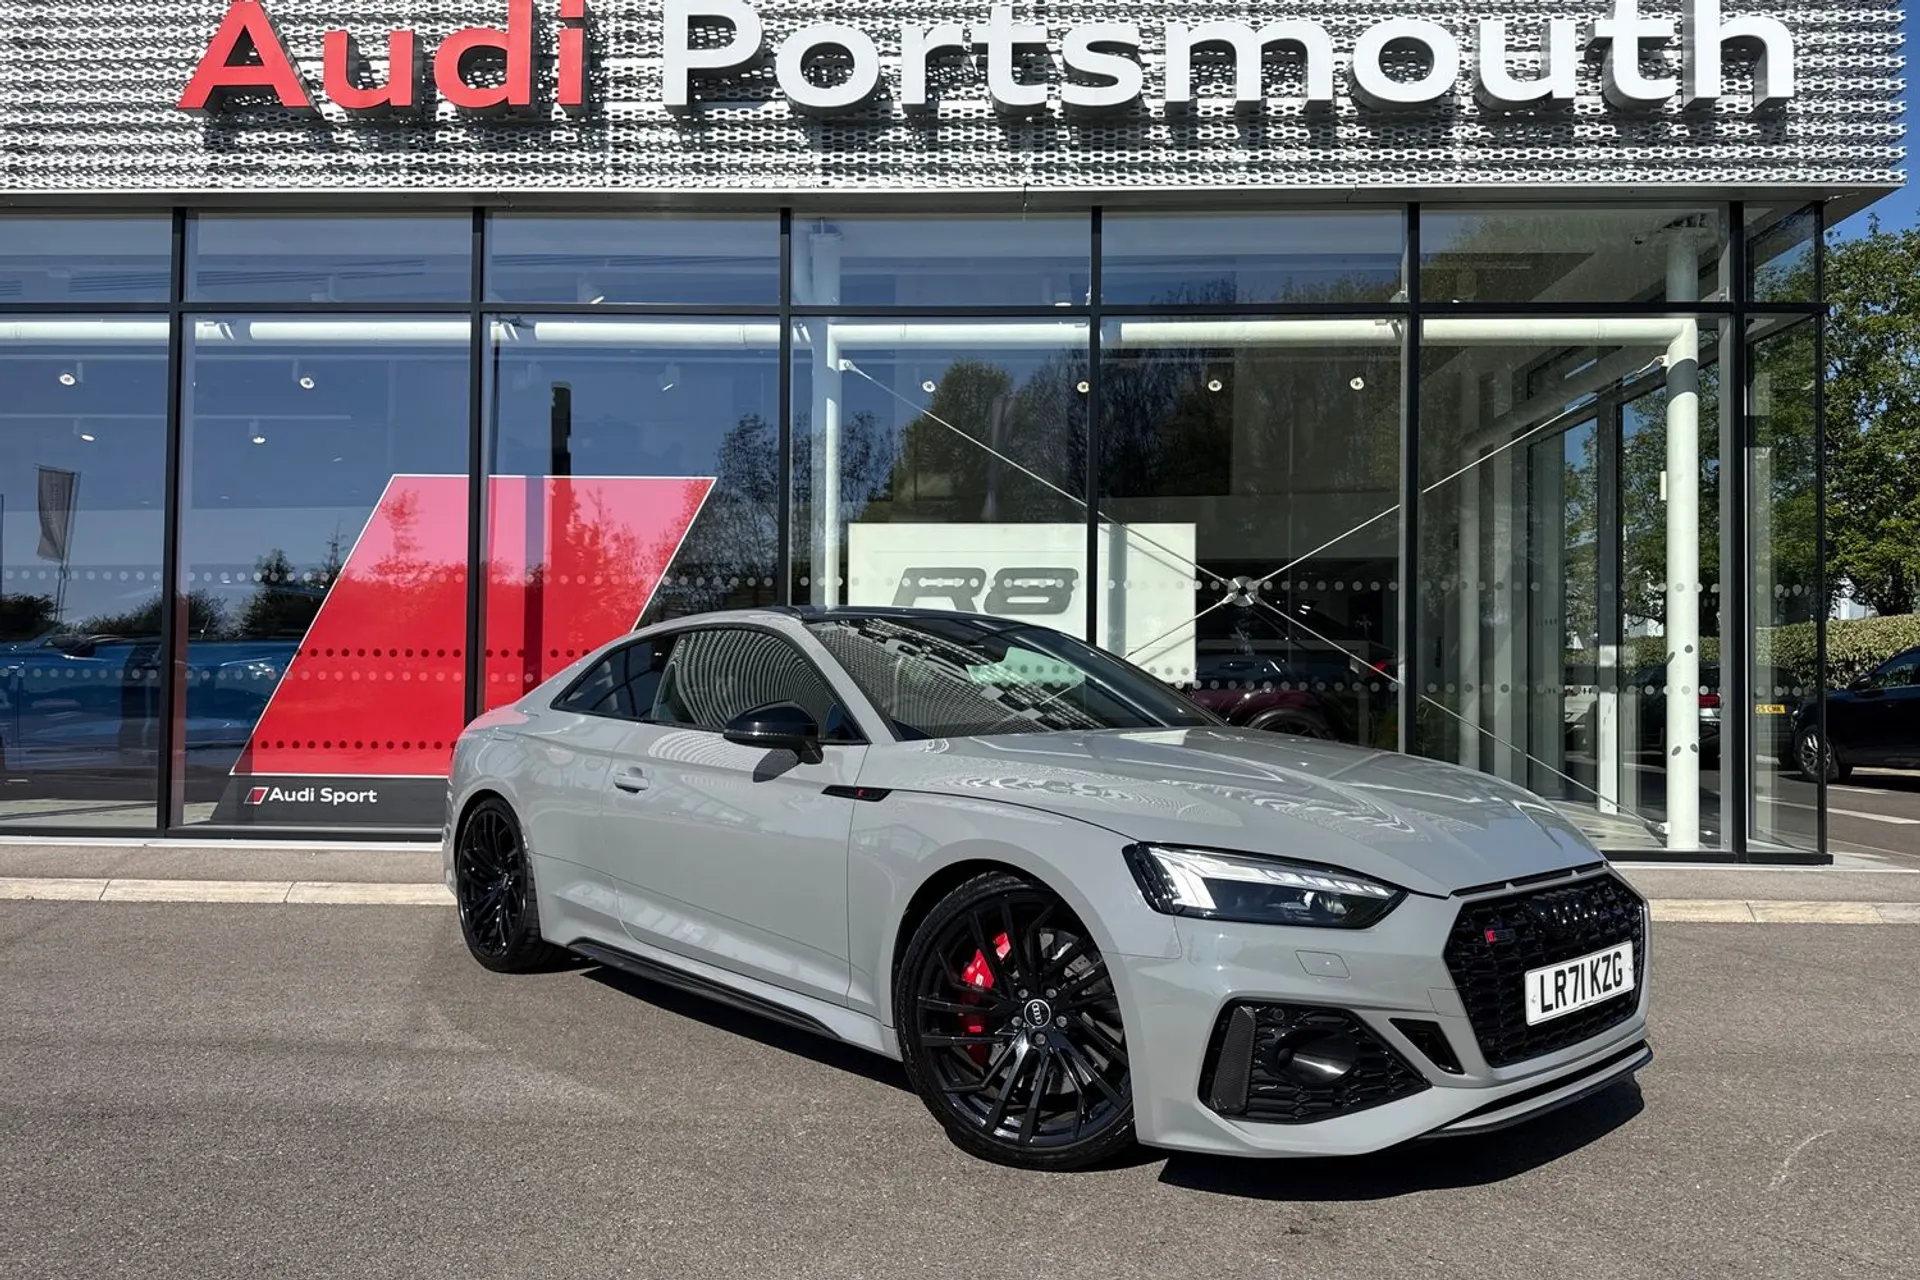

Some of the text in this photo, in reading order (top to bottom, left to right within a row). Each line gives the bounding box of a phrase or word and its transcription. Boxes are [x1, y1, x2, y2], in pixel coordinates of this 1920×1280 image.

[177, 0, 1796, 111] Audi Portsmouth
[891, 567, 1079, 615] R8
[268, 787, 378, 805] Audi Sport
[1540, 951, 1623, 1013] LR71 KZG
